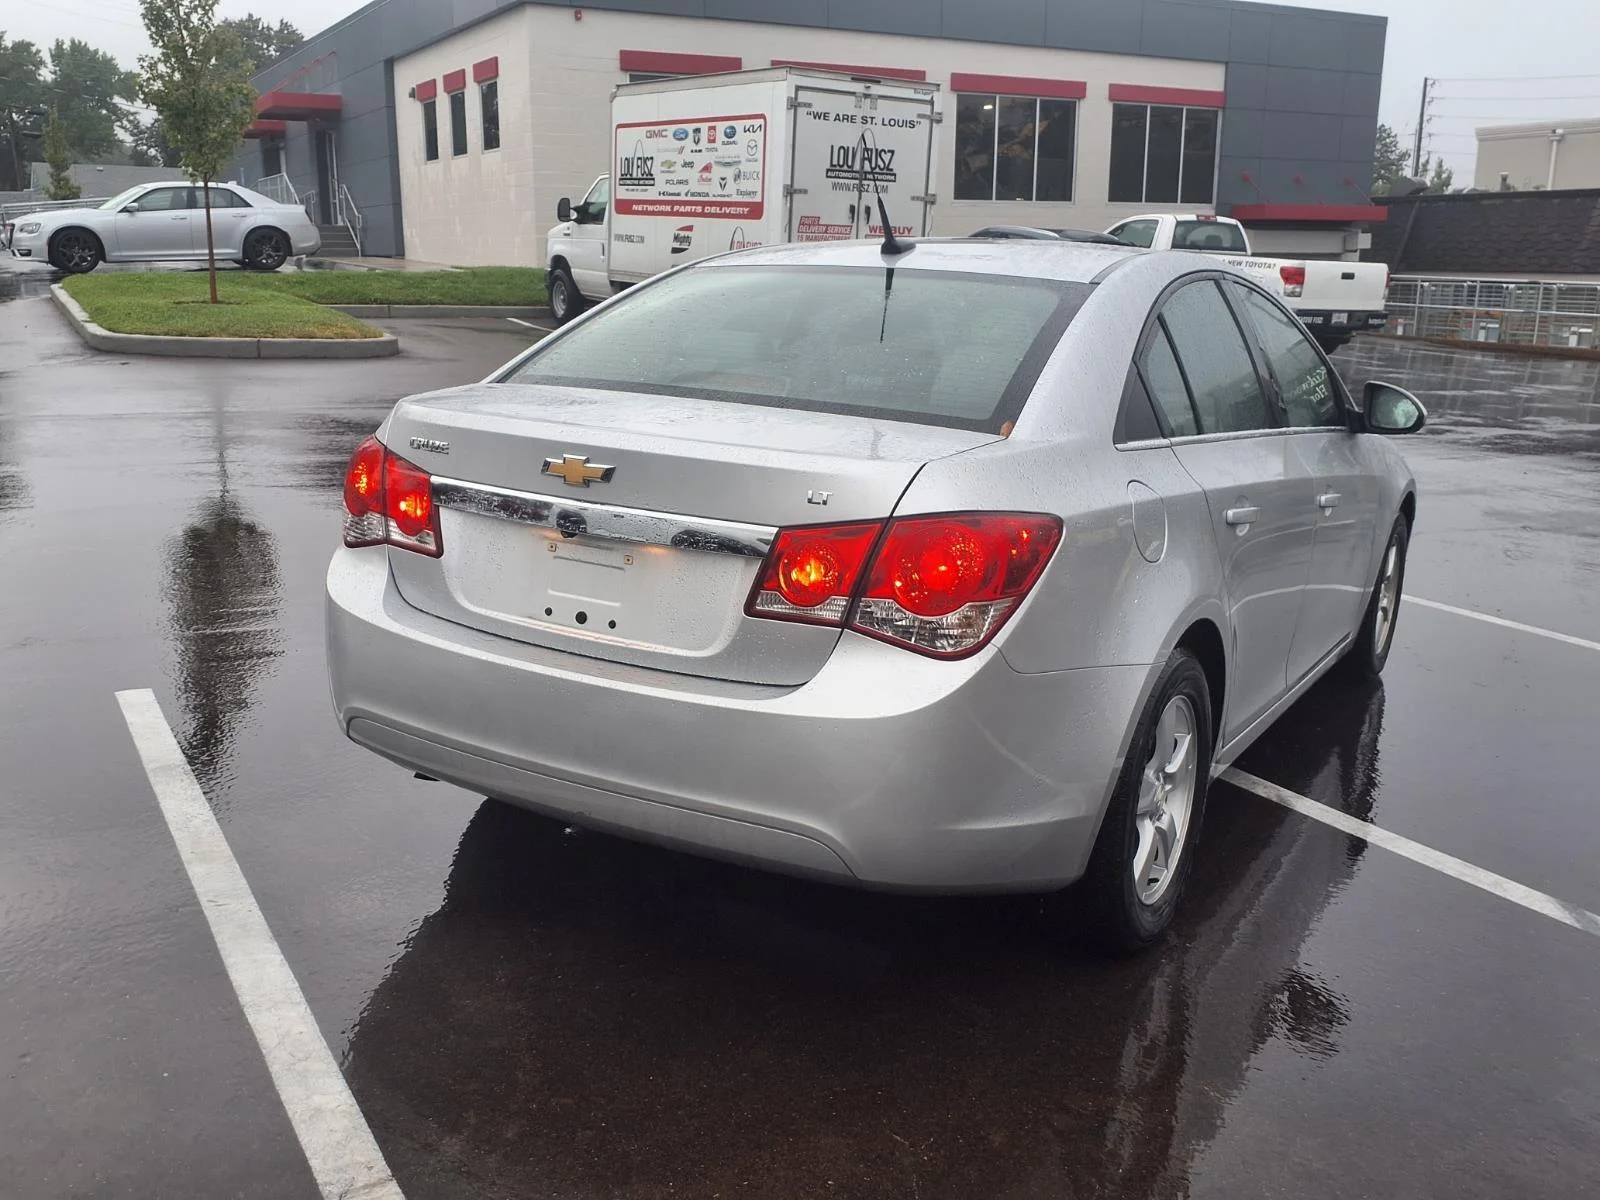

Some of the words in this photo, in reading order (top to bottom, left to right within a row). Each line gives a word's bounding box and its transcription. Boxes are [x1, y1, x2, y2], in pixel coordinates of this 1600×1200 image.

[833, 113, 857, 124] ARE
[861, 115, 878, 126] ST.
[645, 129, 668, 138] GMC
[829, 144, 855, 169] LOU
[620, 156, 634, 177] LOU
[636, 156, 654, 177] FUSZ
[681, 159, 695, 169] Jeep
[632, 204, 672, 212] NETWORK
[673, 205, 702, 213] PARTS
[704, 206, 750, 215] DELIVERY
[801, 217, 818, 225] PARTS
[799, 225, 826, 233] DELIVERY
[827, 225, 852, 234] SERVICE
[672, 232, 692, 246] Mighty
[1245, 260, 1276, 270] TOYOTA?
[409, 436, 450, 455] CRUZE
[807, 490, 834, 506] LT
